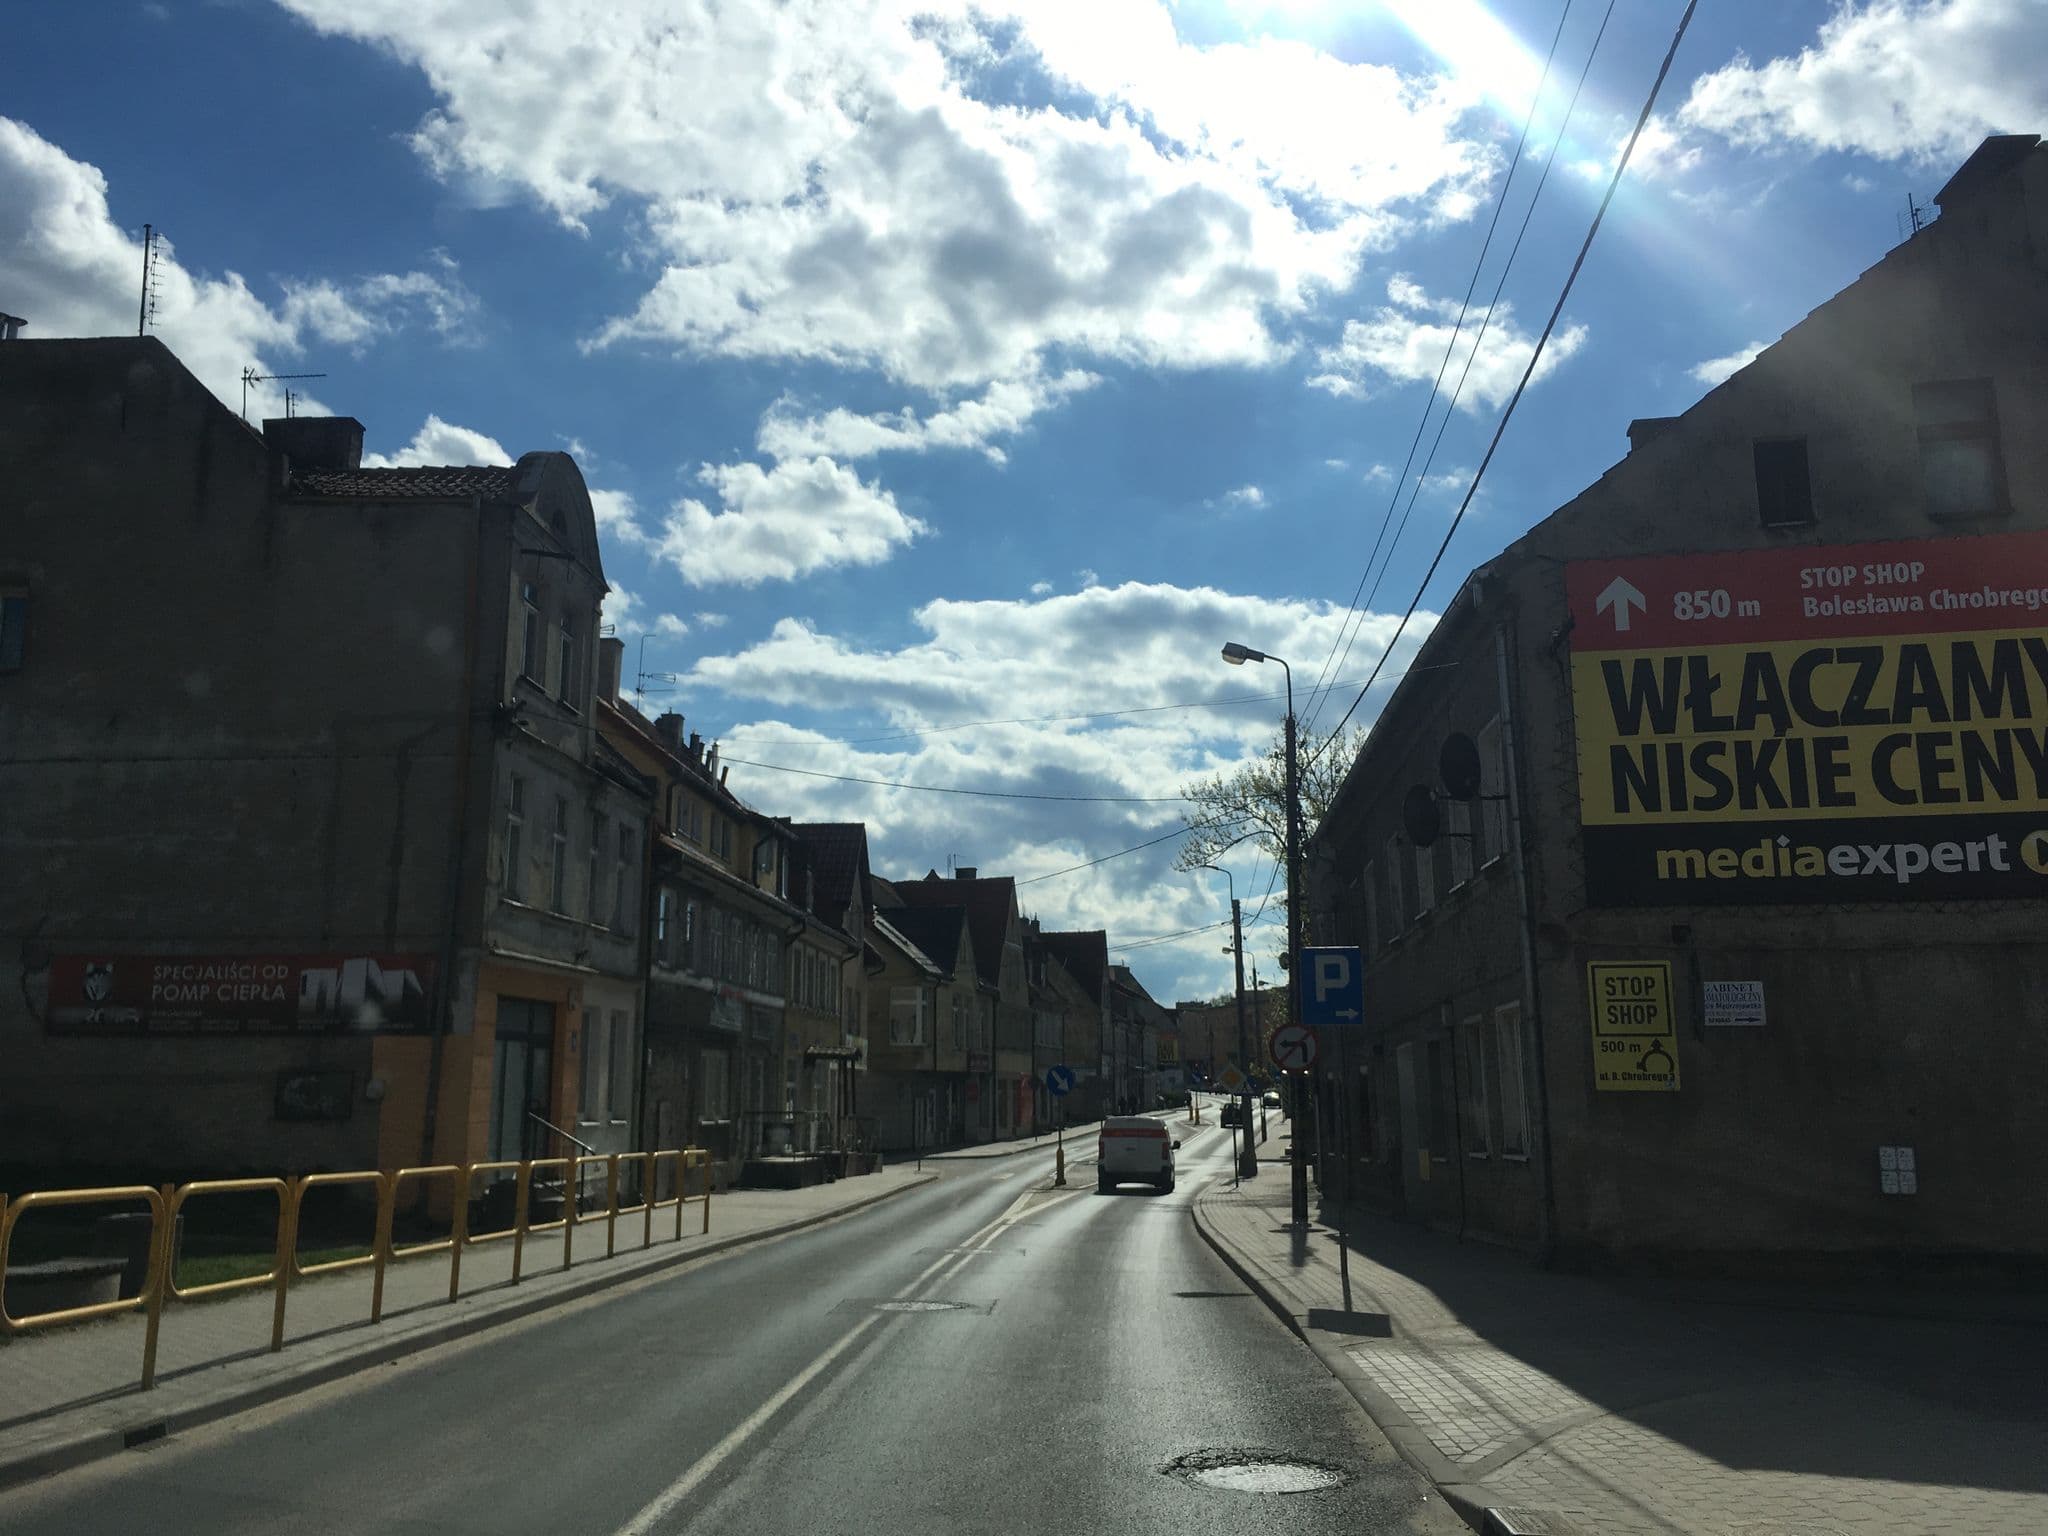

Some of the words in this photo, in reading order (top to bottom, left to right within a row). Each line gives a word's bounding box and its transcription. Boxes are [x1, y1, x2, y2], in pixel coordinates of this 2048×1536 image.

[1800, 565, 1858, 590] STOP
[1864, 561, 1925, 585] SHOP
[1673, 589, 1731, 621] 850
[1738, 598, 1761, 616] m
[1802, 595, 1924, 618] Bolesława
[1609, 735, 1857, 814] NISKIE
[1656, 832, 2011, 884] mediaexpert
[152, 962, 256, 980] SPECJALIŚCI
[261, 964, 289, 979] OD
[1314, 954, 1350, 1002] P
[151, 983, 210, 1001] POMP
[216, 983, 287, 1001] CIEPŁA
[1605, 976, 1655, 996] STOP
[1607, 1005, 1657, 1024] SHOP
[1601, 1041, 1624, 1053] 500
[1629, 1044, 1641, 1053] m
